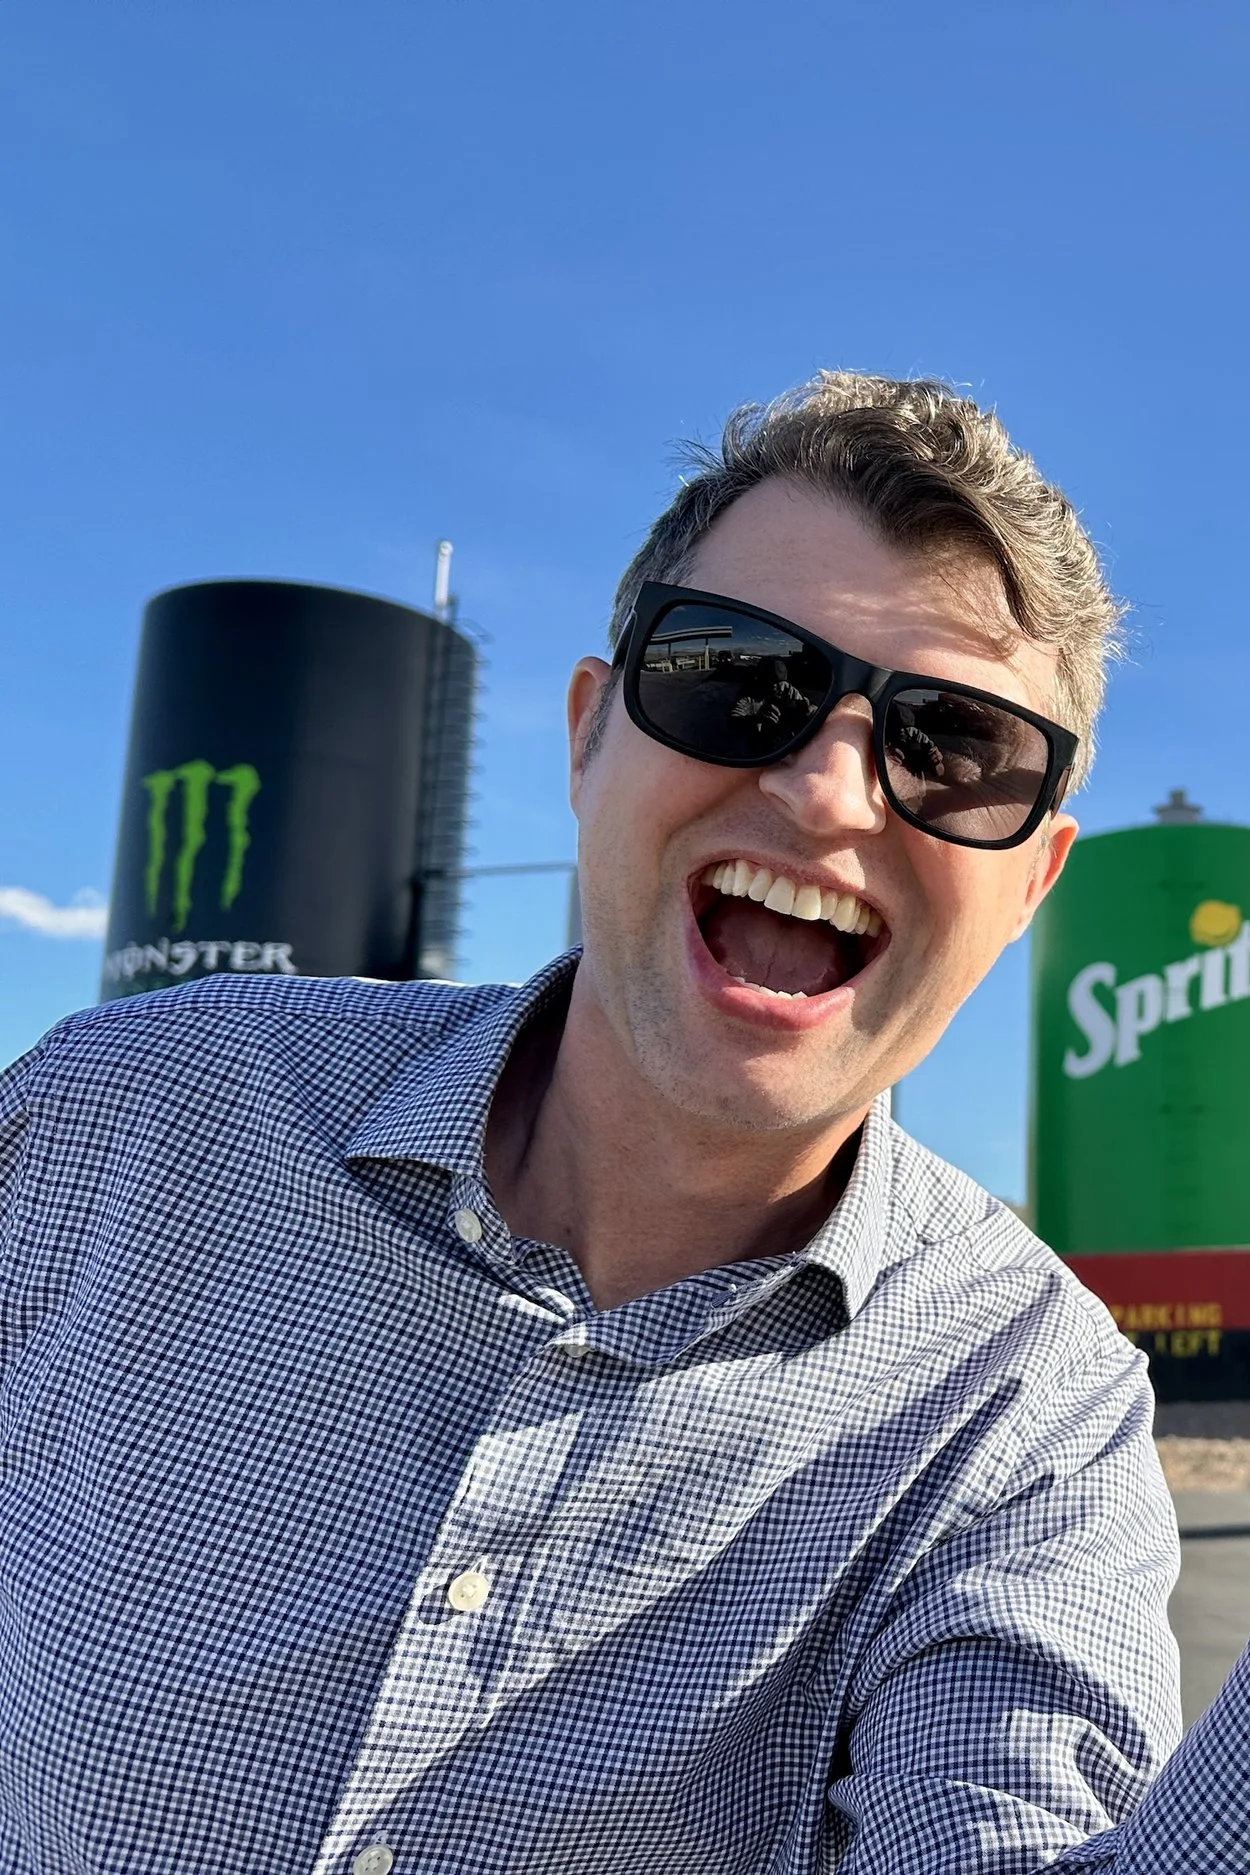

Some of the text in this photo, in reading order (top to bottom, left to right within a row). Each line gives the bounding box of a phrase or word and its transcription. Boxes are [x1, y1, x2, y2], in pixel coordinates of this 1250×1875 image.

[104, 936, 299, 981] MONSTER
[1108, 1302, 1222, 1329] PARKING
[1154, 1329, 1222, 1357] LEFT
